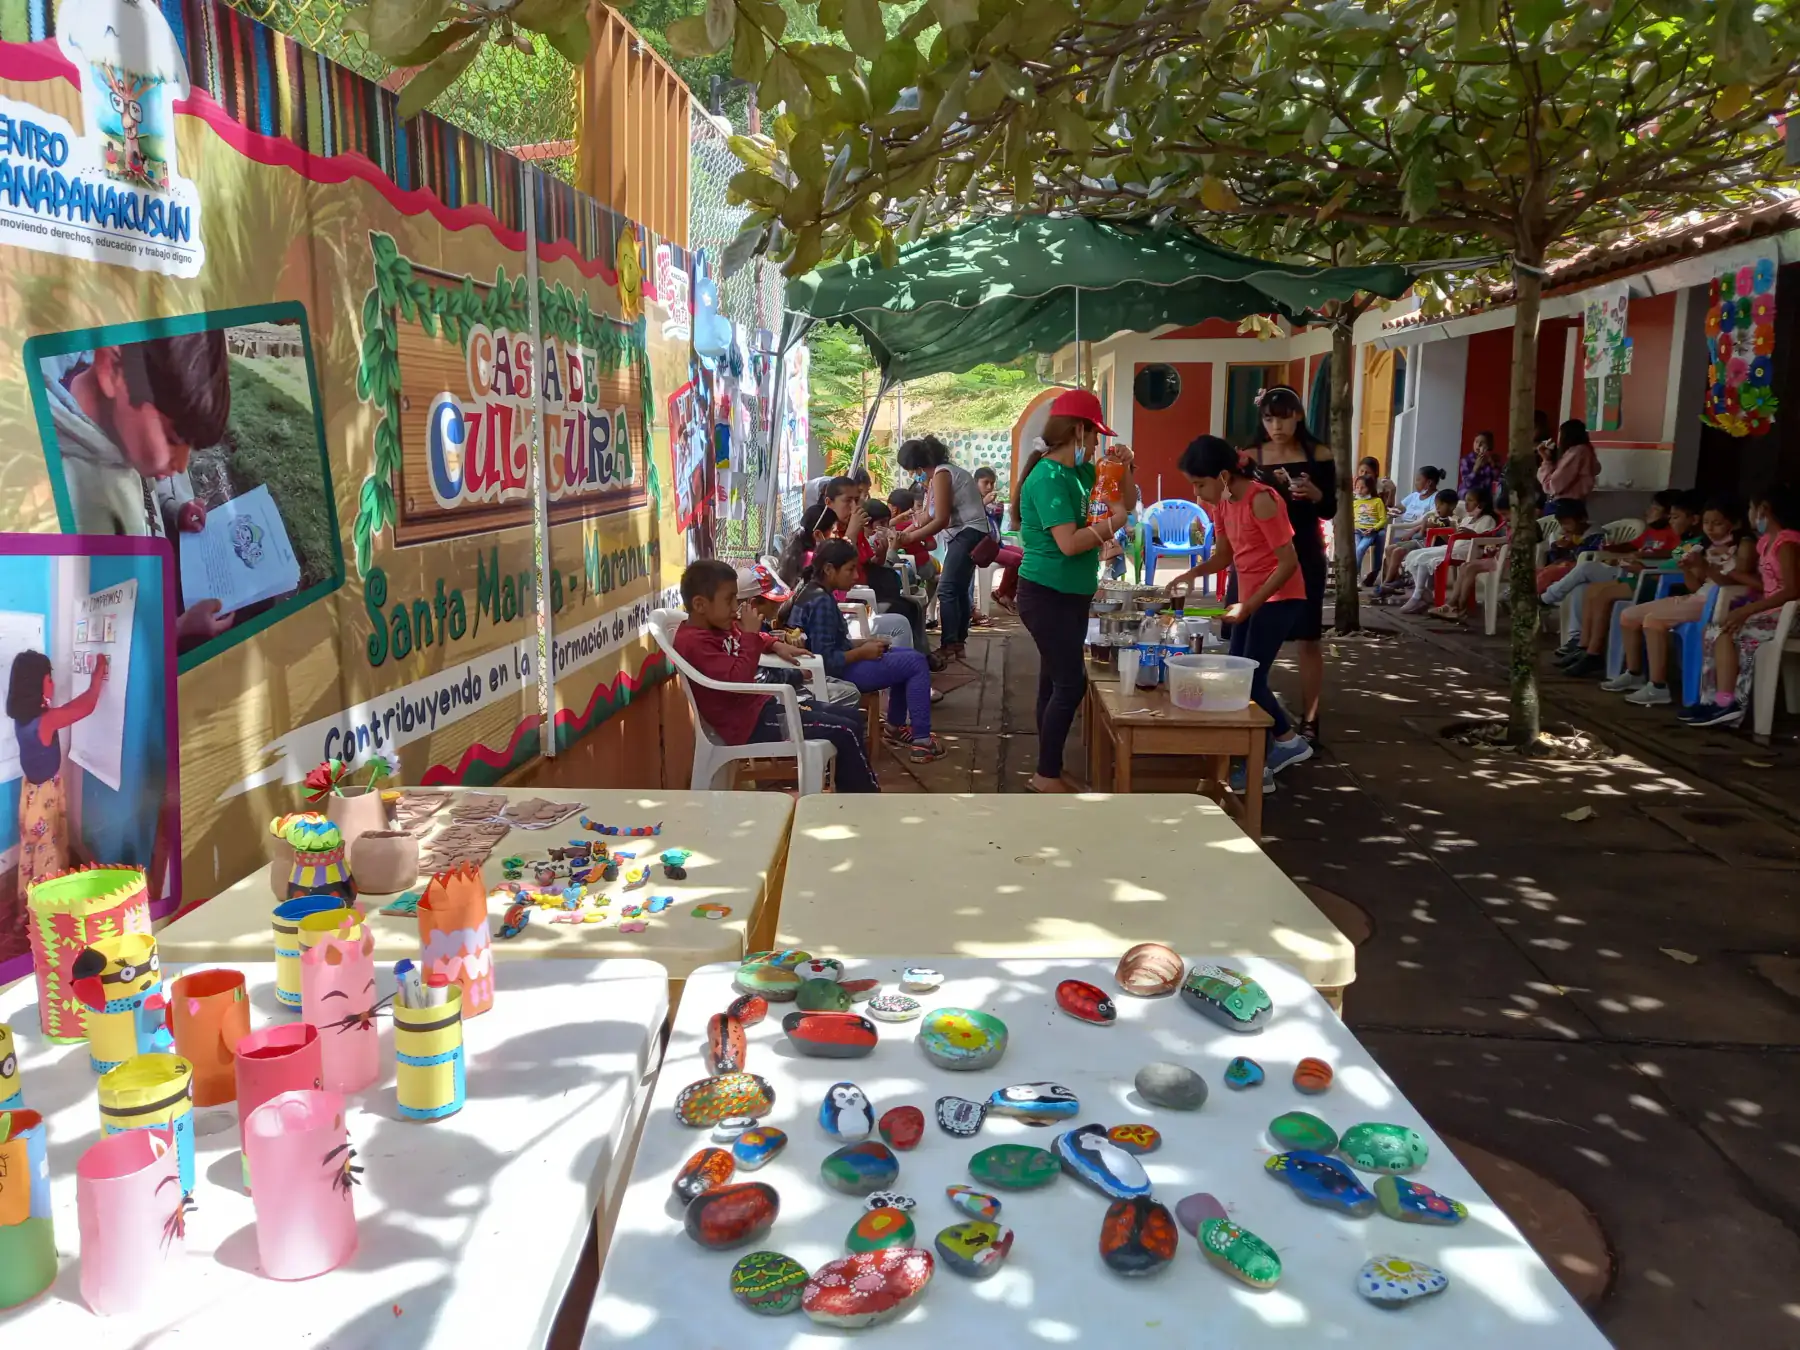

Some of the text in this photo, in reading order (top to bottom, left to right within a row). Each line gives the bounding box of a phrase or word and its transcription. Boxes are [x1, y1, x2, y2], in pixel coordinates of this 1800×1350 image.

[51, 228, 93, 246] derechos,
[96, 237, 137, 253] educación
[138, 246, 143, 256] y
[145, 248, 170, 260] trabajo
[172, 252, 192, 264] digno
[470, 332, 598, 405] CASA DE
[430, 401, 633, 500] CULTURA
[365, 566, 467, 667] Santa
[324, 666, 482, 762] Contribuyendo
[489, 663, 508, 692] en
[514, 646, 531, 679] la
[612, 611, 624, 641] de
